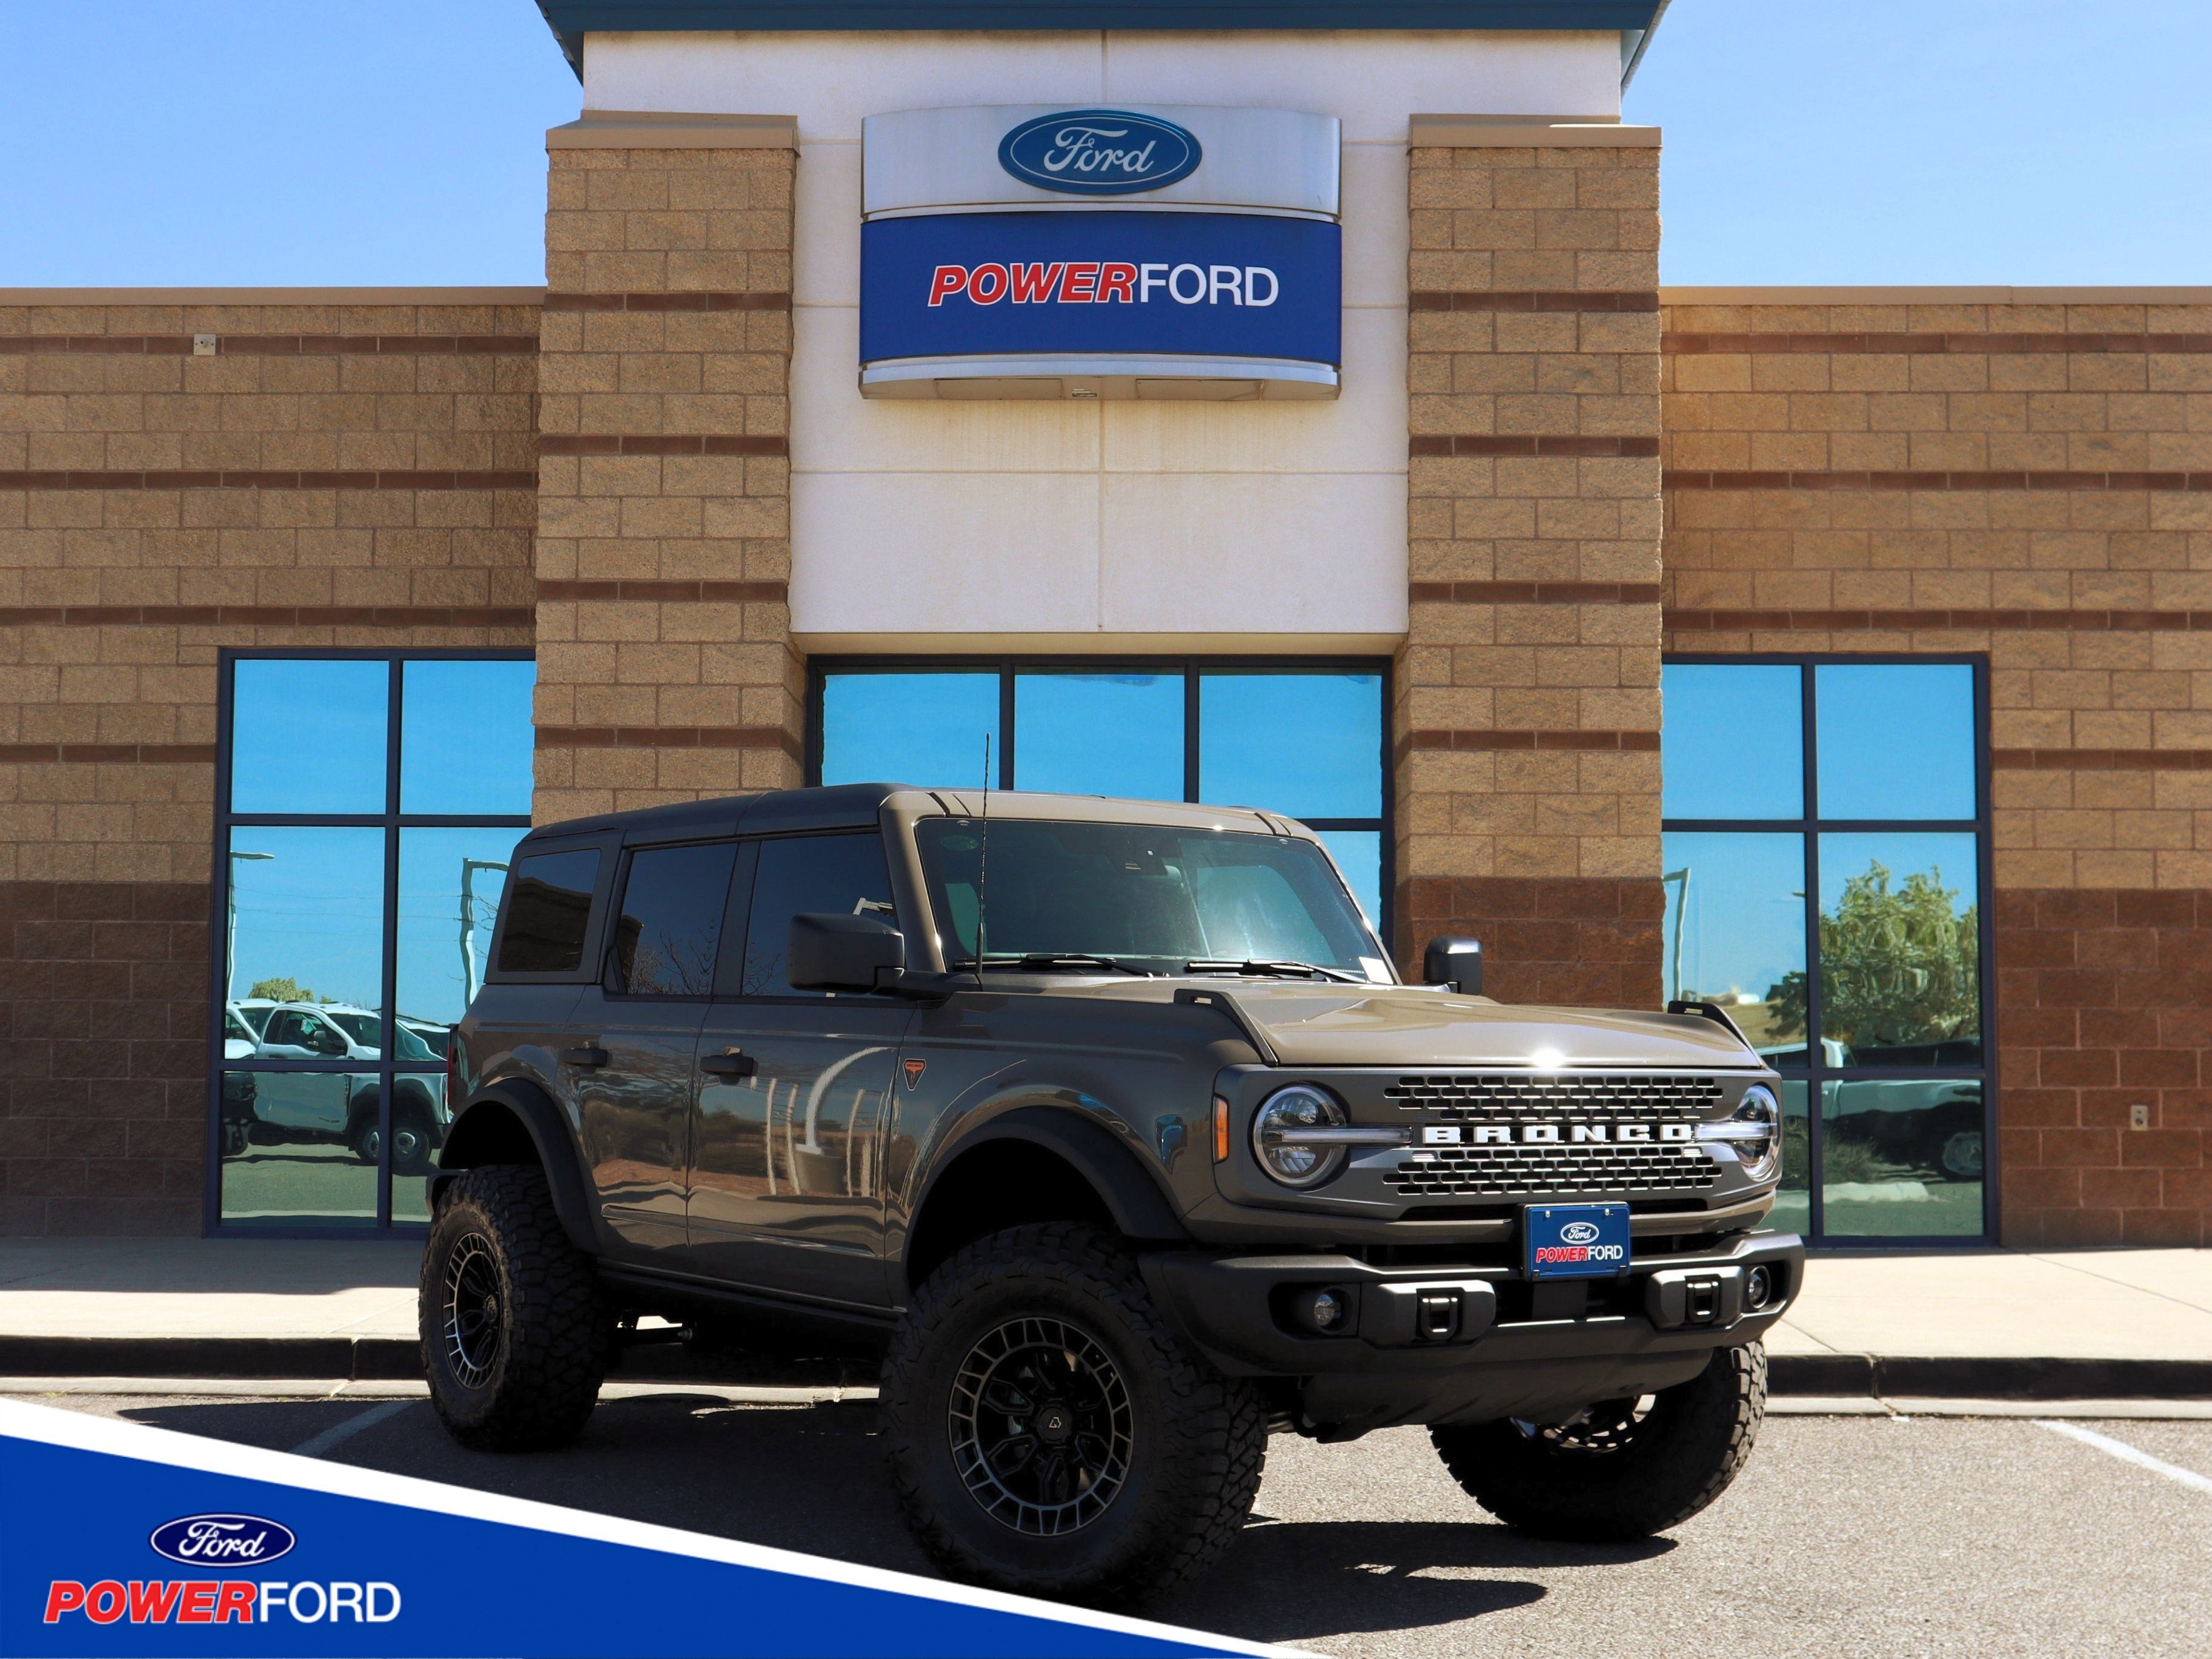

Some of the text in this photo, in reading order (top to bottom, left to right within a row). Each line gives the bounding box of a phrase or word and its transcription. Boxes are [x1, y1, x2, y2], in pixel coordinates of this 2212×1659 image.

[1043, 125, 1157, 173] Ford
[927, 262, 1280, 307] POWERFORD
[1422, 1124, 1692, 1144] BRONCO
[1567, 1226, 1591, 1240] Ford
[1536, 1245, 1623, 1263] POWERFORD
